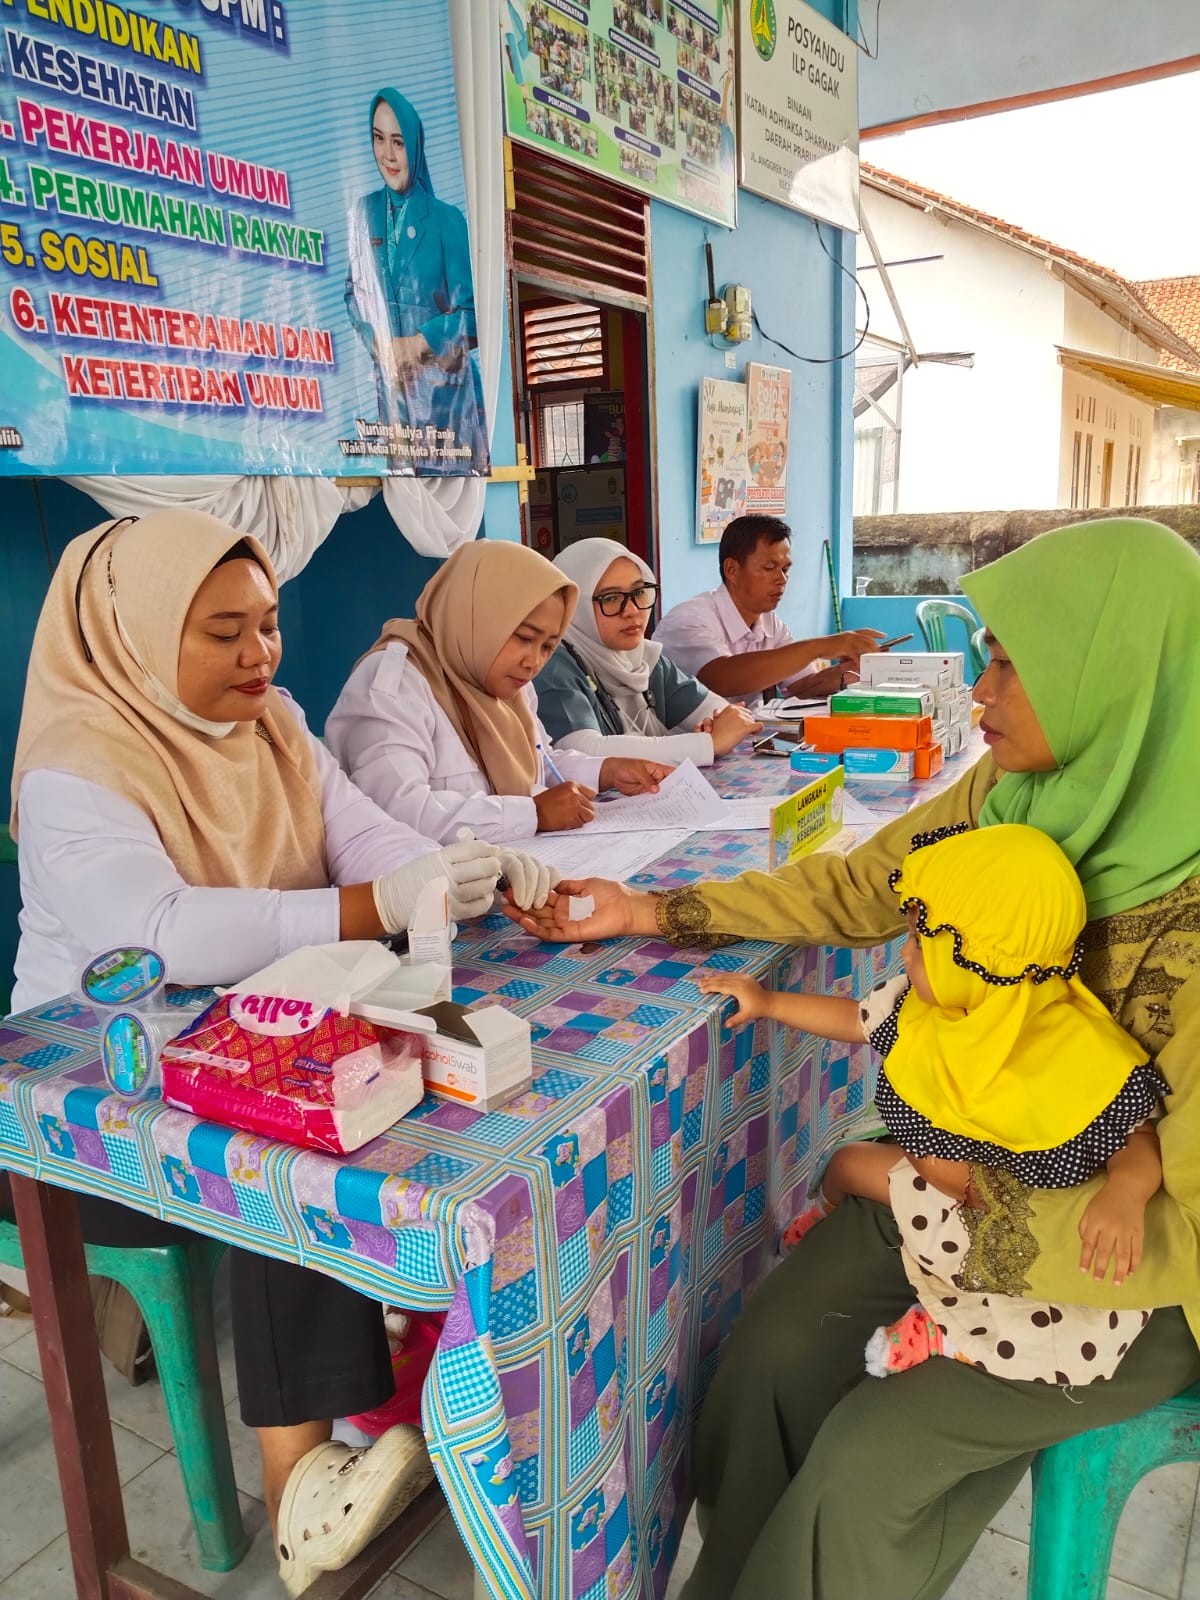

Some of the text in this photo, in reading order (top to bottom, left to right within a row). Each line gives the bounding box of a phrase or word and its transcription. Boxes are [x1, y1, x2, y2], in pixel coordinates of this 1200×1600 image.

[4, 0, 201, 75] NDIDIKAN
[788, 15, 845, 73] POSYANDU
[5, 27, 196, 130] KESEHATAN
[792, 51, 840, 100] ILP GAGAK
[744, 93, 768, 120] IKATAN
[768, 108, 803, 140] ADHYAKSA
[787, 96, 813, 121] BINAAN
[17, 97, 204, 190] PEKERJAAN
[207, 155, 291, 208] UMUM
[765, 128, 819, 162] DAERAH PRABU
[28, 163, 225, 247] PERUMAHAN
[231, 216, 325, 267] RAKYAT
[0, 222, 158, 287] 5. SOSIAL
[11, 285, 334, 365] 6. KETENTERAMAN DAN
[62, 355, 324, 412] KETERTIBAN UMUM
[0, 429, 21, 445] lih
[425, 425, 456, 440] Franky
[797, 787, 822, 812] LANGKAH
[796, 815, 826, 846] KESEHATAN
